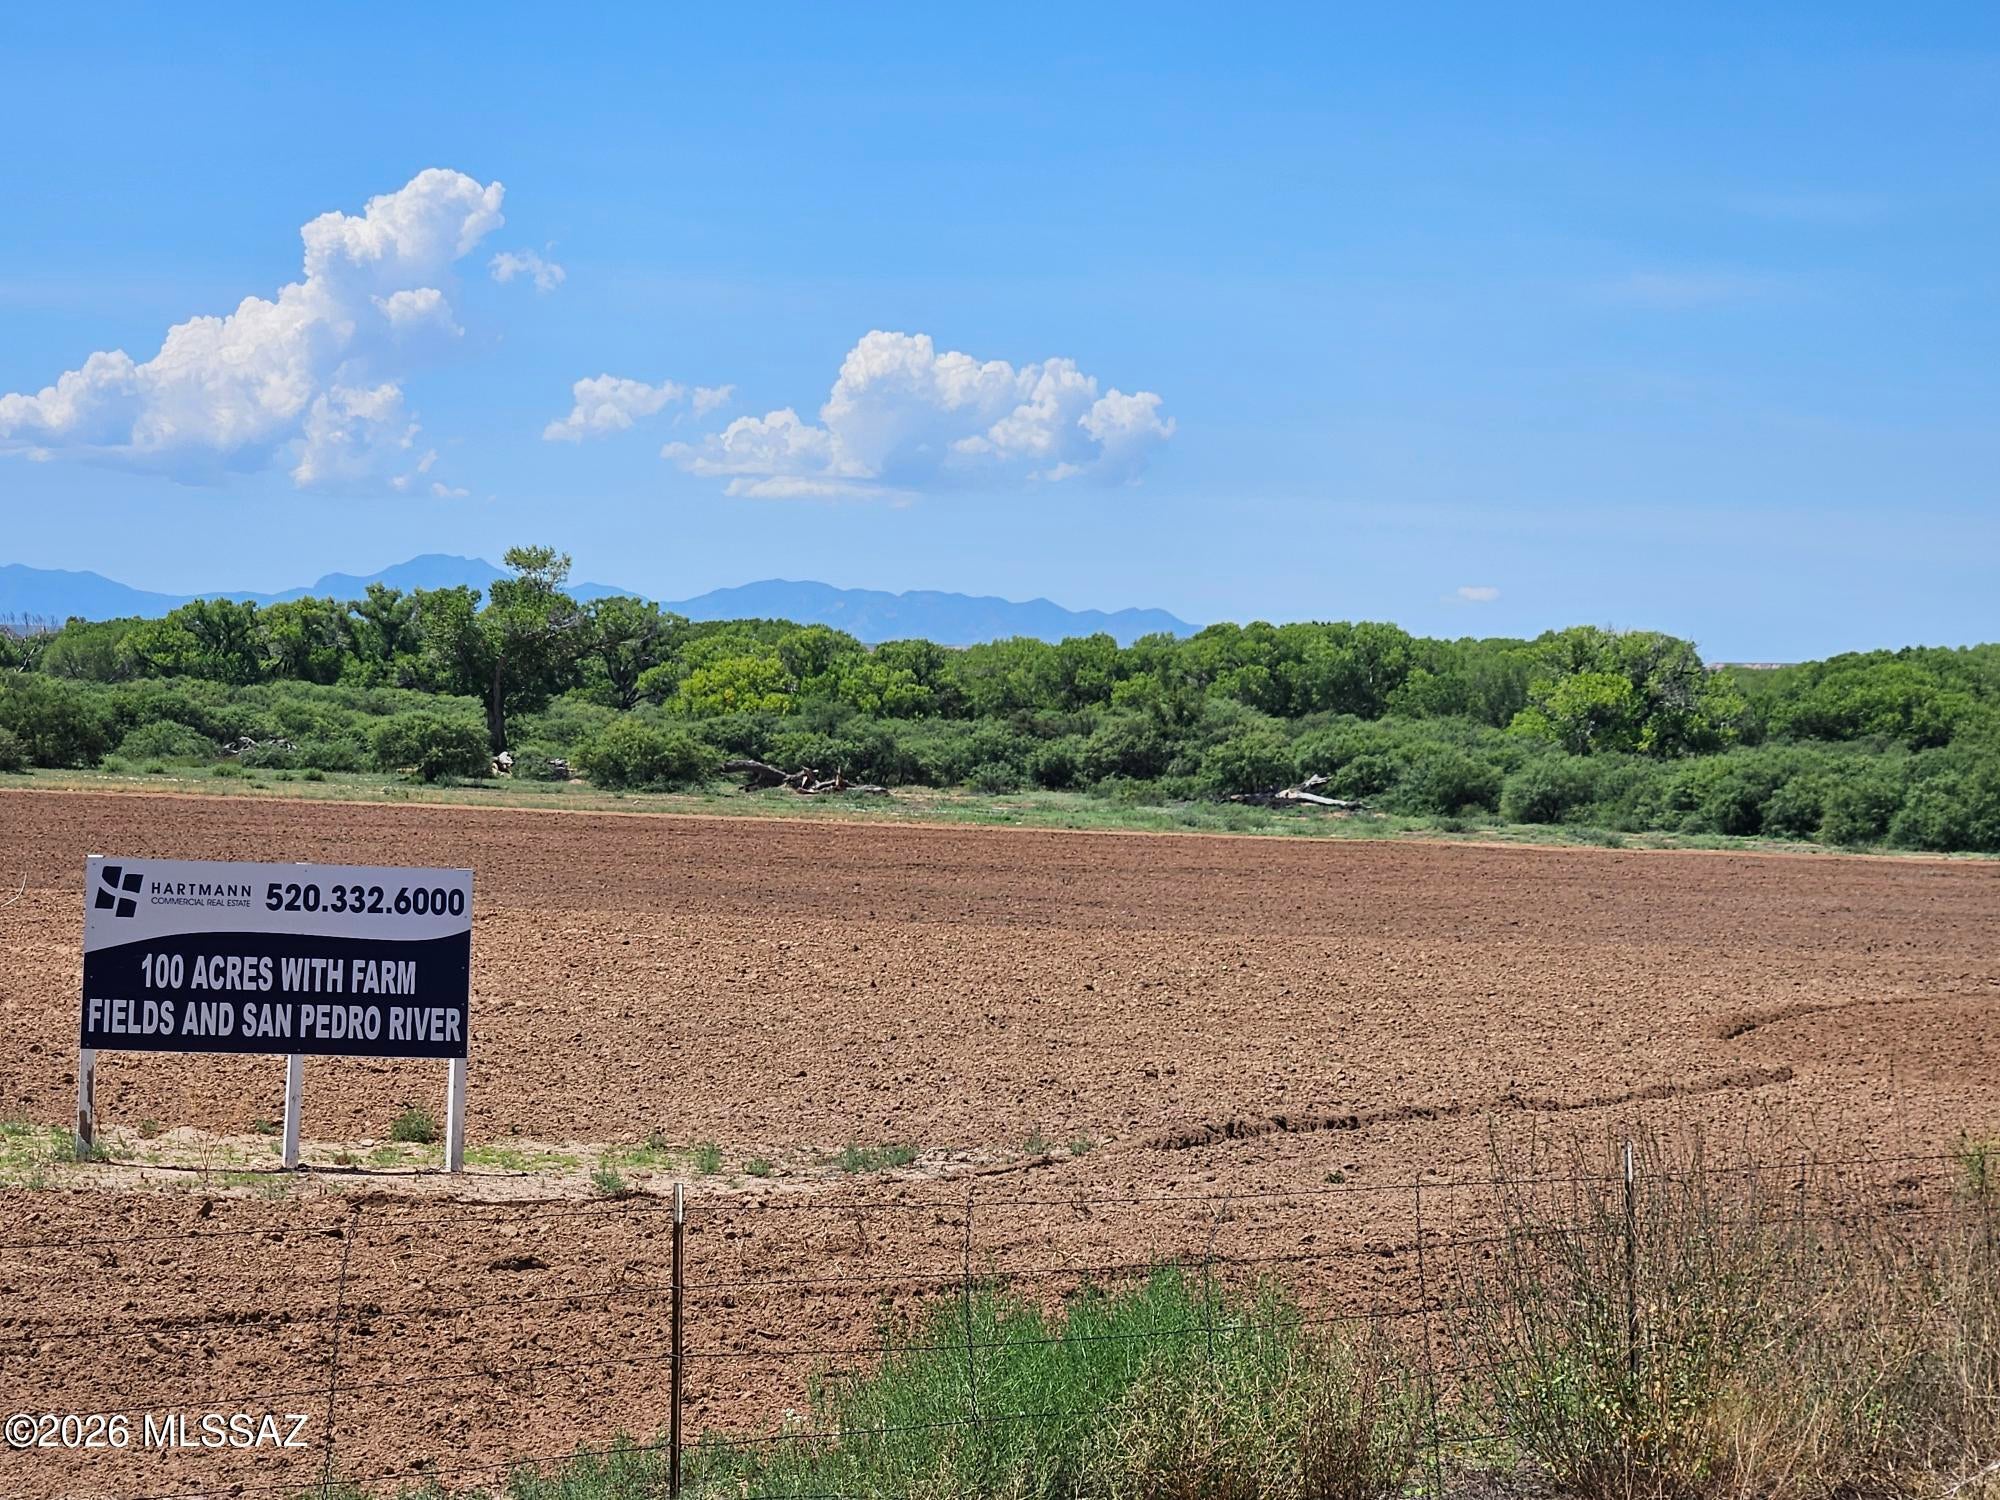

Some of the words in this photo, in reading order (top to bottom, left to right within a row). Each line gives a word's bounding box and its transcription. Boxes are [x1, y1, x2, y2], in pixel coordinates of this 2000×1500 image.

[150, 897, 205, 906] COMMERCIAL
[206, 898, 225, 907] REAL
[227, 899, 251, 907] ESTATE
[151, 882, 252, 897] HARTMANN
[265, 883, 465, 916] 520.332.6000
[141, 953, 184, 989] 100
[191, 955, 273, 991] ACRES
[281, 957, 343, 993] WITH
[351, 959, 416, 995] FARM
[87, 998, 175, 1035] FIELDS
[182, 1001, 235, 1037] AND
[242, 1002, 292, 1038] SAN
[300, 1004, 381, 1040] PEDRO
[389, 1006, 461, 1042] RIVER
